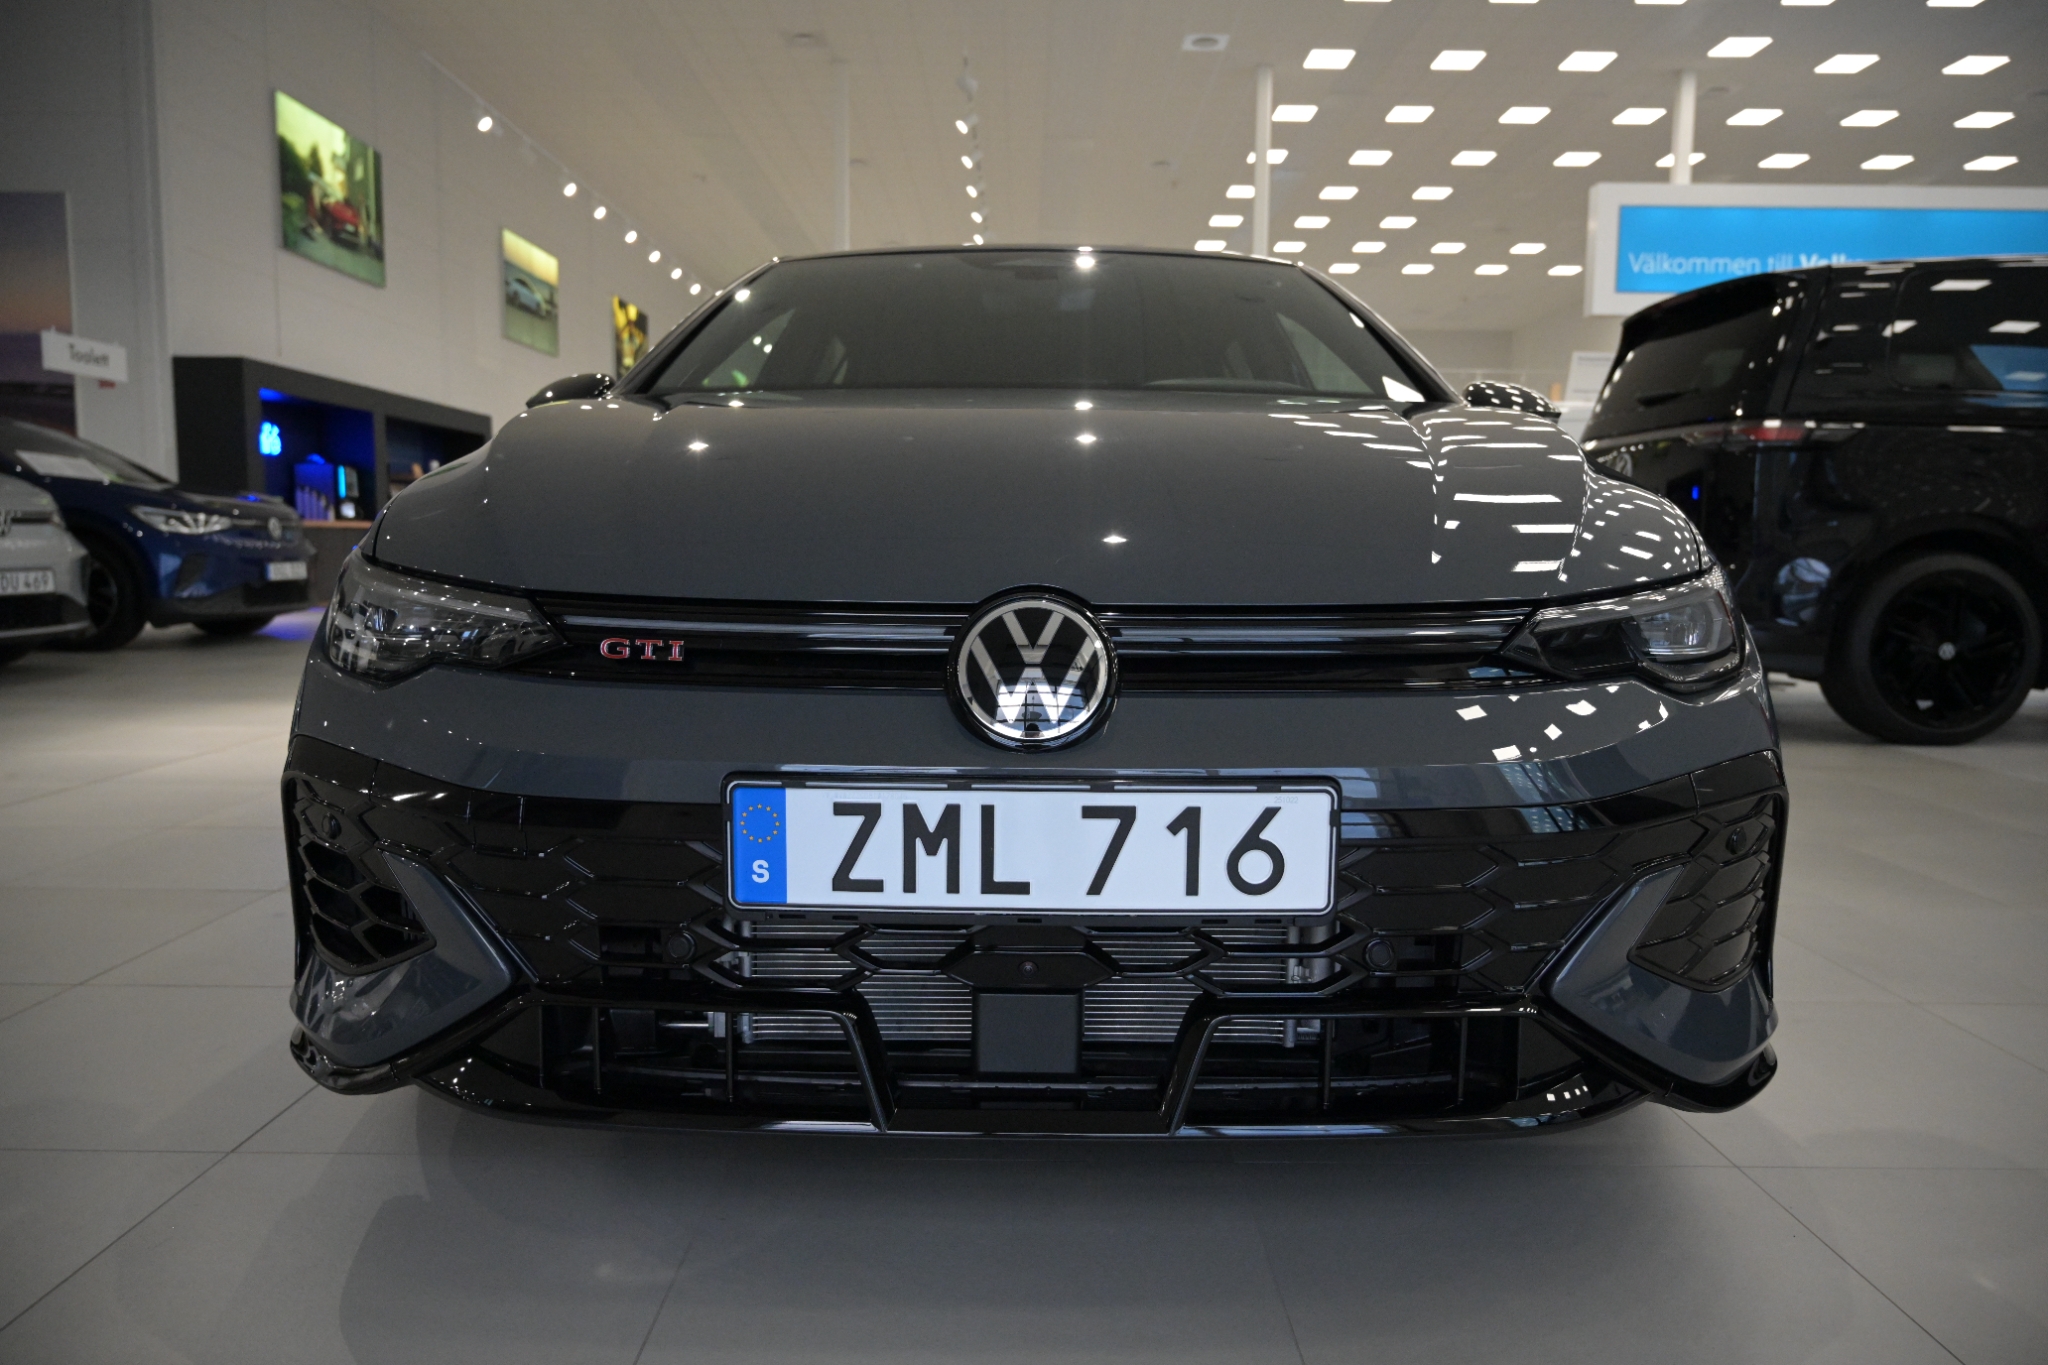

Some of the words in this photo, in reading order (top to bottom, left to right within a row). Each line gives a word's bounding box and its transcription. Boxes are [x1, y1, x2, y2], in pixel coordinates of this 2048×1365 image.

[1628, 252, 1760, 275] Välkommen
[600, 637, 684, 661] GTI
[832, 802, 1031, 895] ZML
[1081, 806, 1285, 897] 716
[752, 859, 770, 883] S
